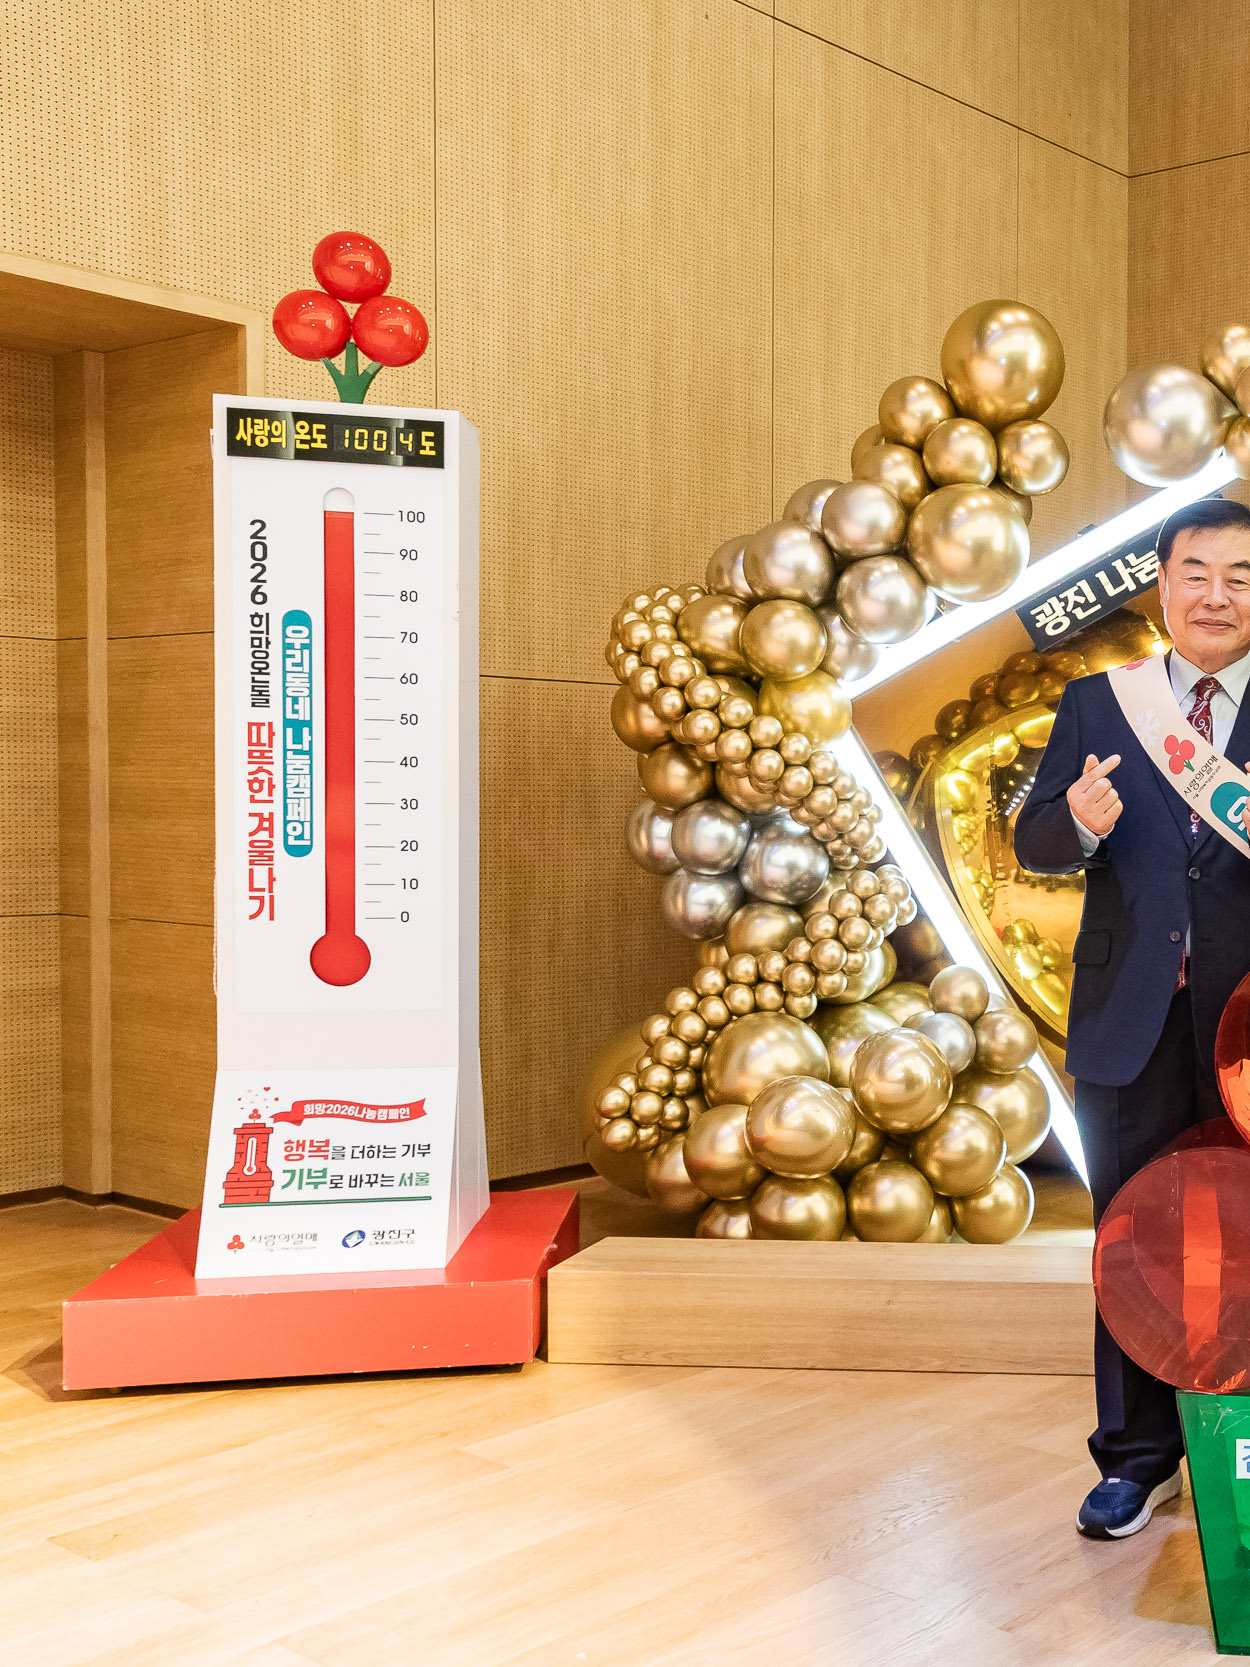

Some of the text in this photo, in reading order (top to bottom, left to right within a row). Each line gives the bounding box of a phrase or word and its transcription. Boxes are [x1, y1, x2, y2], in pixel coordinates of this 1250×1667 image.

[235, 416, 287, 449] 사랑의
[294, 420, 328, 450] 온도
[419, 430, 436, 456] 도
[398, 510, 426, 524] 100
[399, 548, 418, 561] 90
[399, 590, 418, 603] 80
[1029, 578, 1102, 637] 광진
[400, 631, 419, 644] 70
[400, 672, 419, 685] 60
[247, 518, 277, 922] 2026 희망온돌 따뜻한 겨울나기
[400, 713, 419, 726] 50
[284, 624, 312, 846] 우리동네 나눔캠페인
[400, 756, 419, 768] 40
[400, 798, 419, 810] 30
[400, 839, 419, 852] 20
[400, 877, 419, 890] 10
[400, 911, 410, 923] 0
[283, 1138, 432, 1162] 행복을 더하는 기부
[280, 1167, 430, 1191] 기부로 바꾸는 서울
[370, 1228, 416, 1240] 광진구
